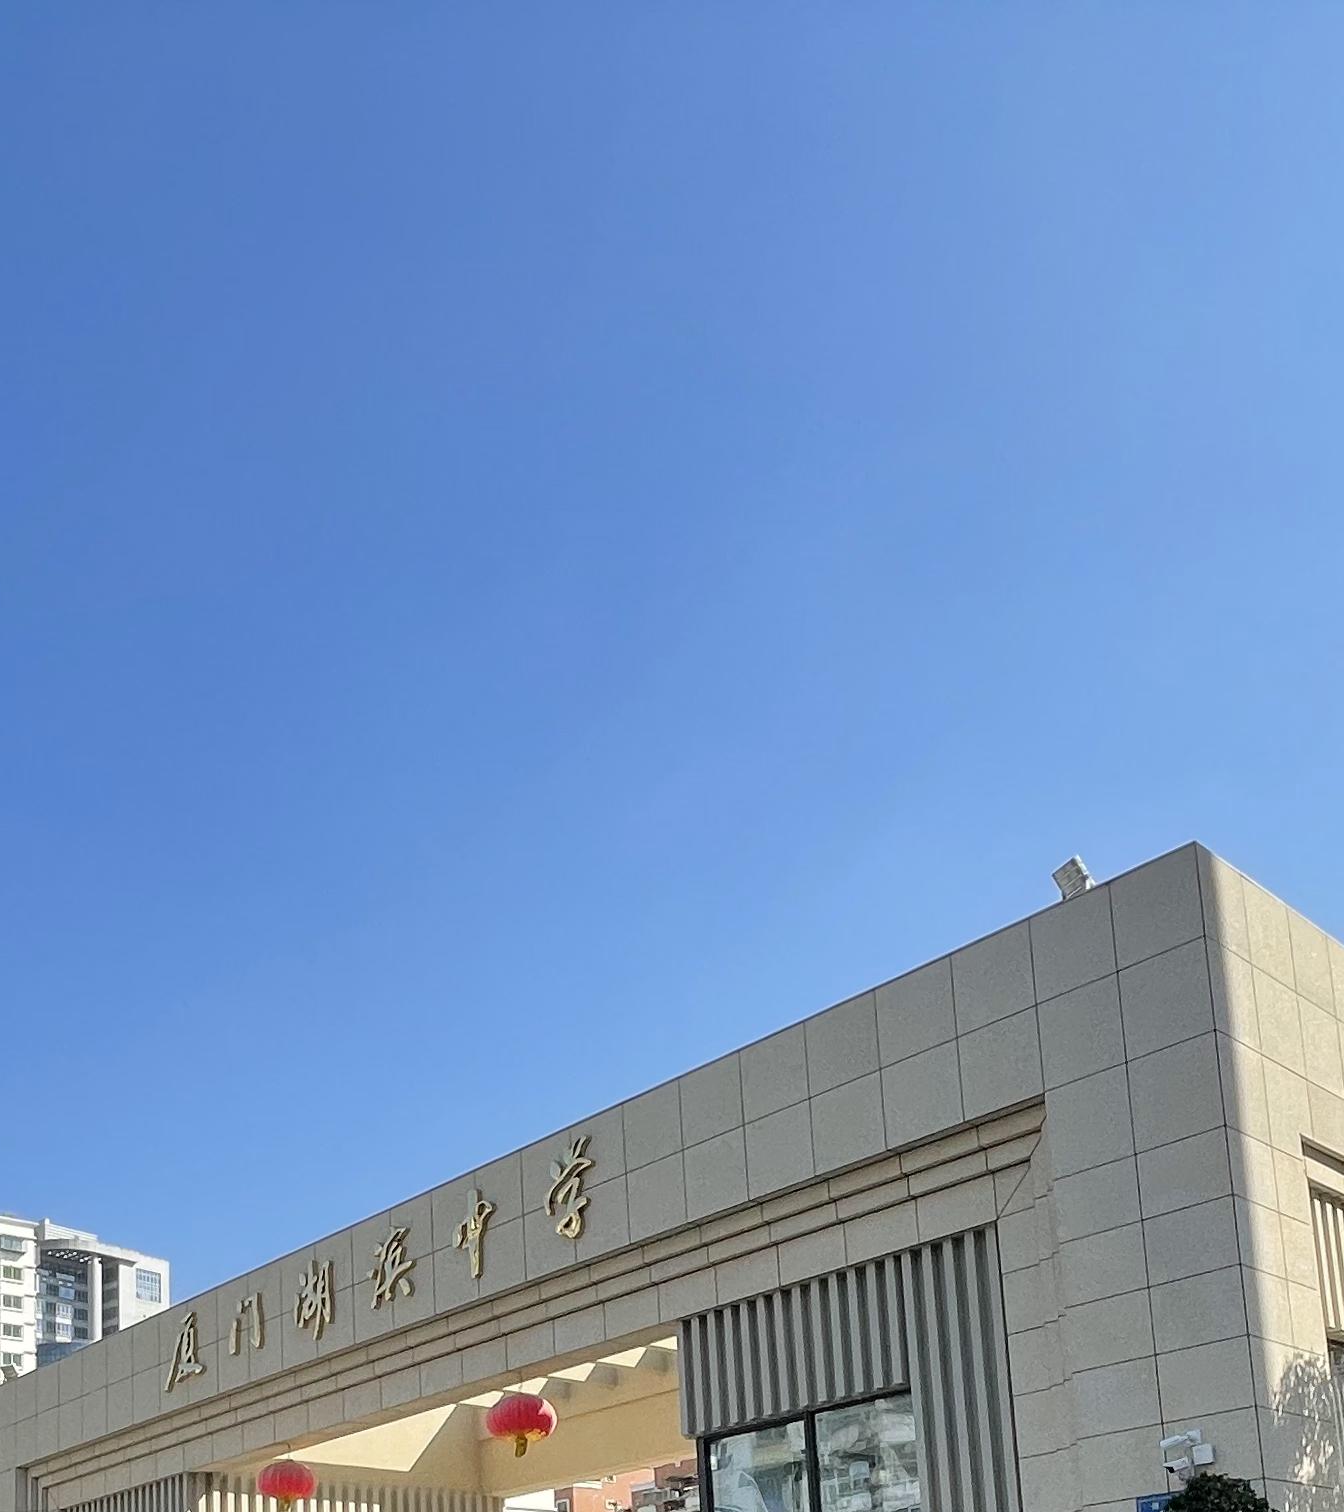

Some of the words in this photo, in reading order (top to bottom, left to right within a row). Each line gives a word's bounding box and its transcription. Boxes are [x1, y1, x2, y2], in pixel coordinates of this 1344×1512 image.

[164, 1134, 595, 1393] 厦门湖滨中学
